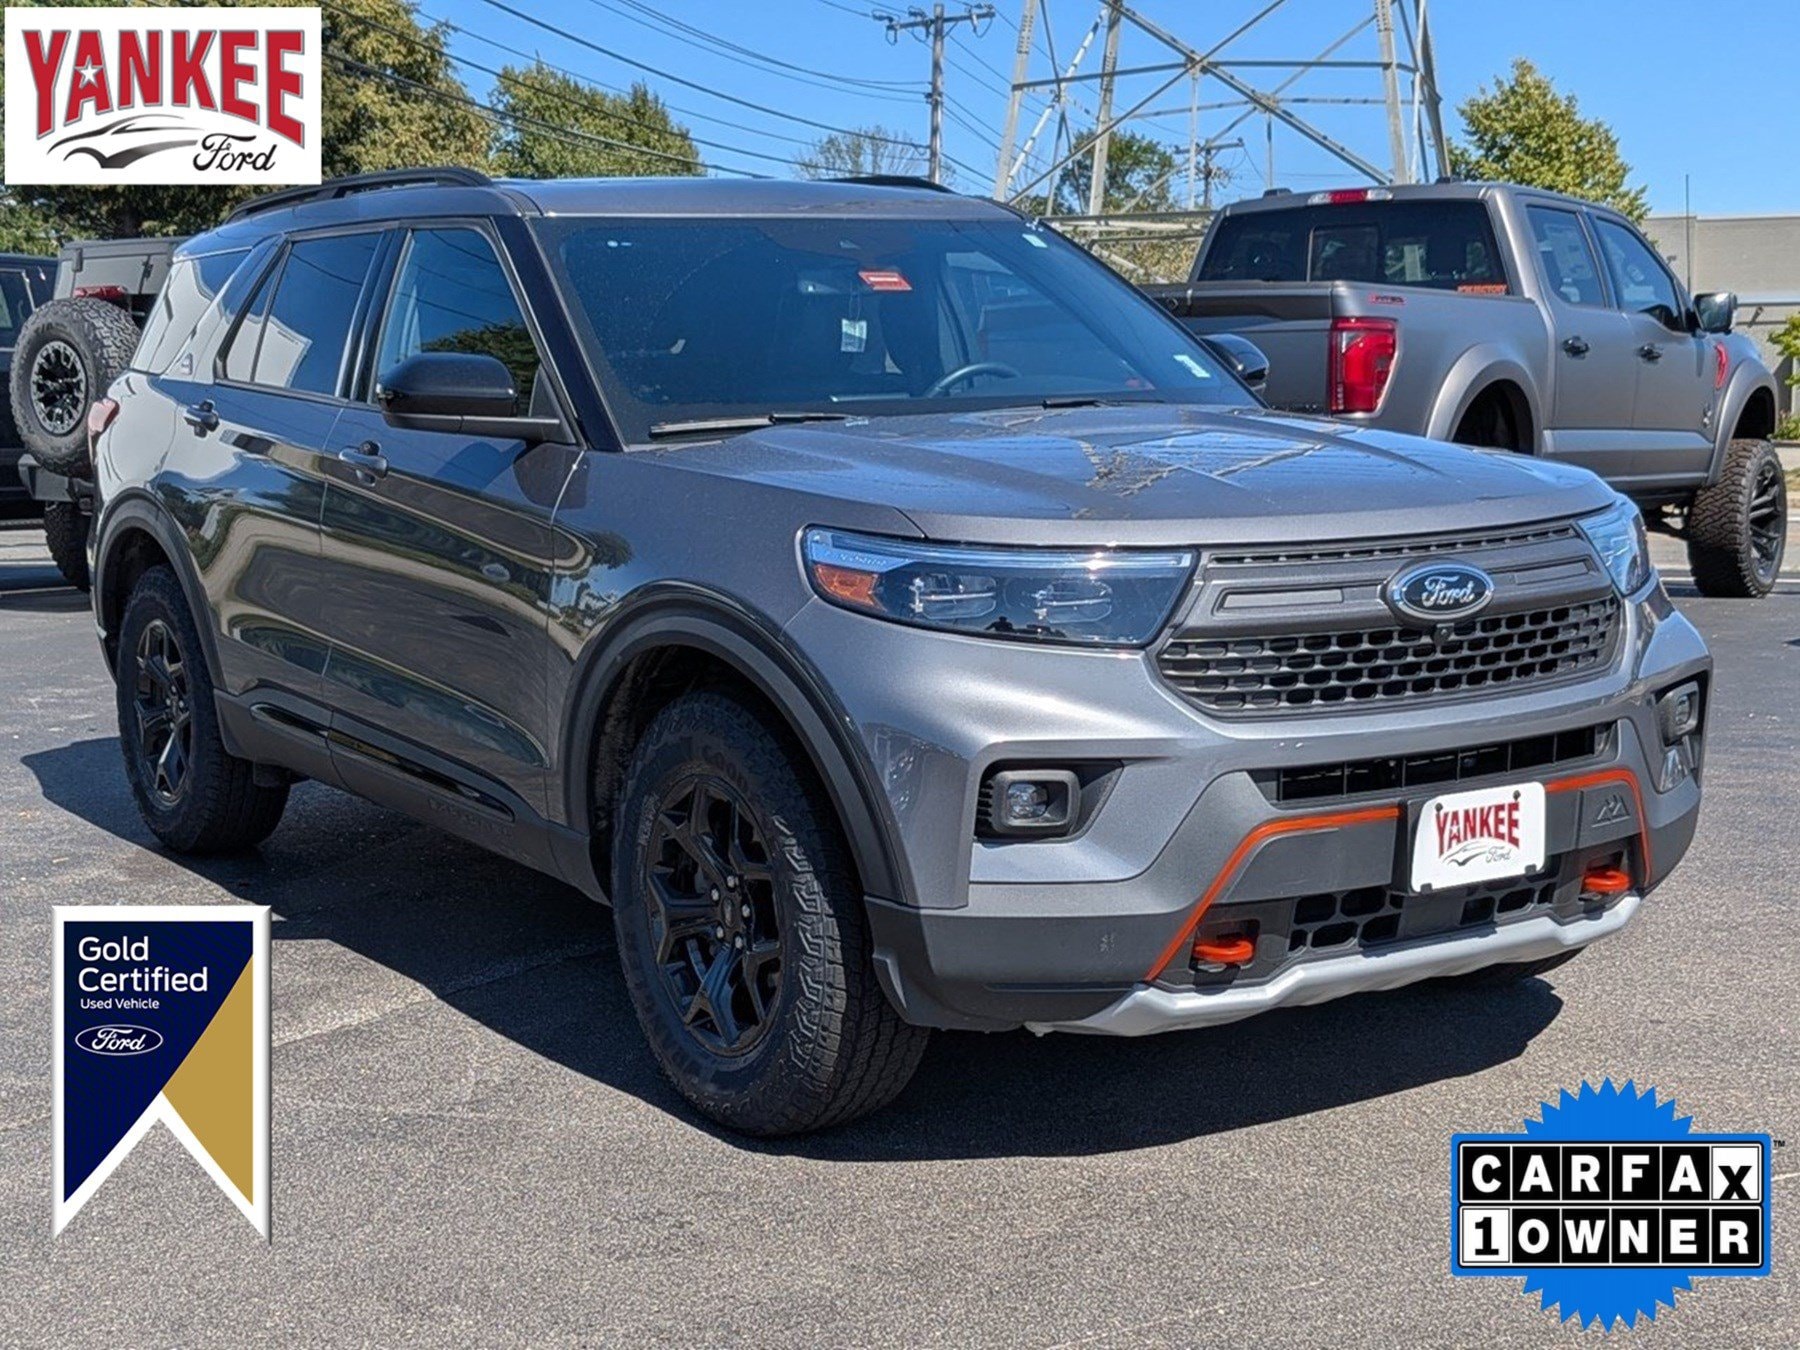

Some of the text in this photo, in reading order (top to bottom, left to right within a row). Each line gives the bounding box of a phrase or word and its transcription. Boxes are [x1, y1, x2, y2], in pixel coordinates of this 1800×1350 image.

[1421, 575, 1476, 608] Ford
[1435, 800, 1520, 859] YANKEE
[1485, 845, 1512, 864] Ford
